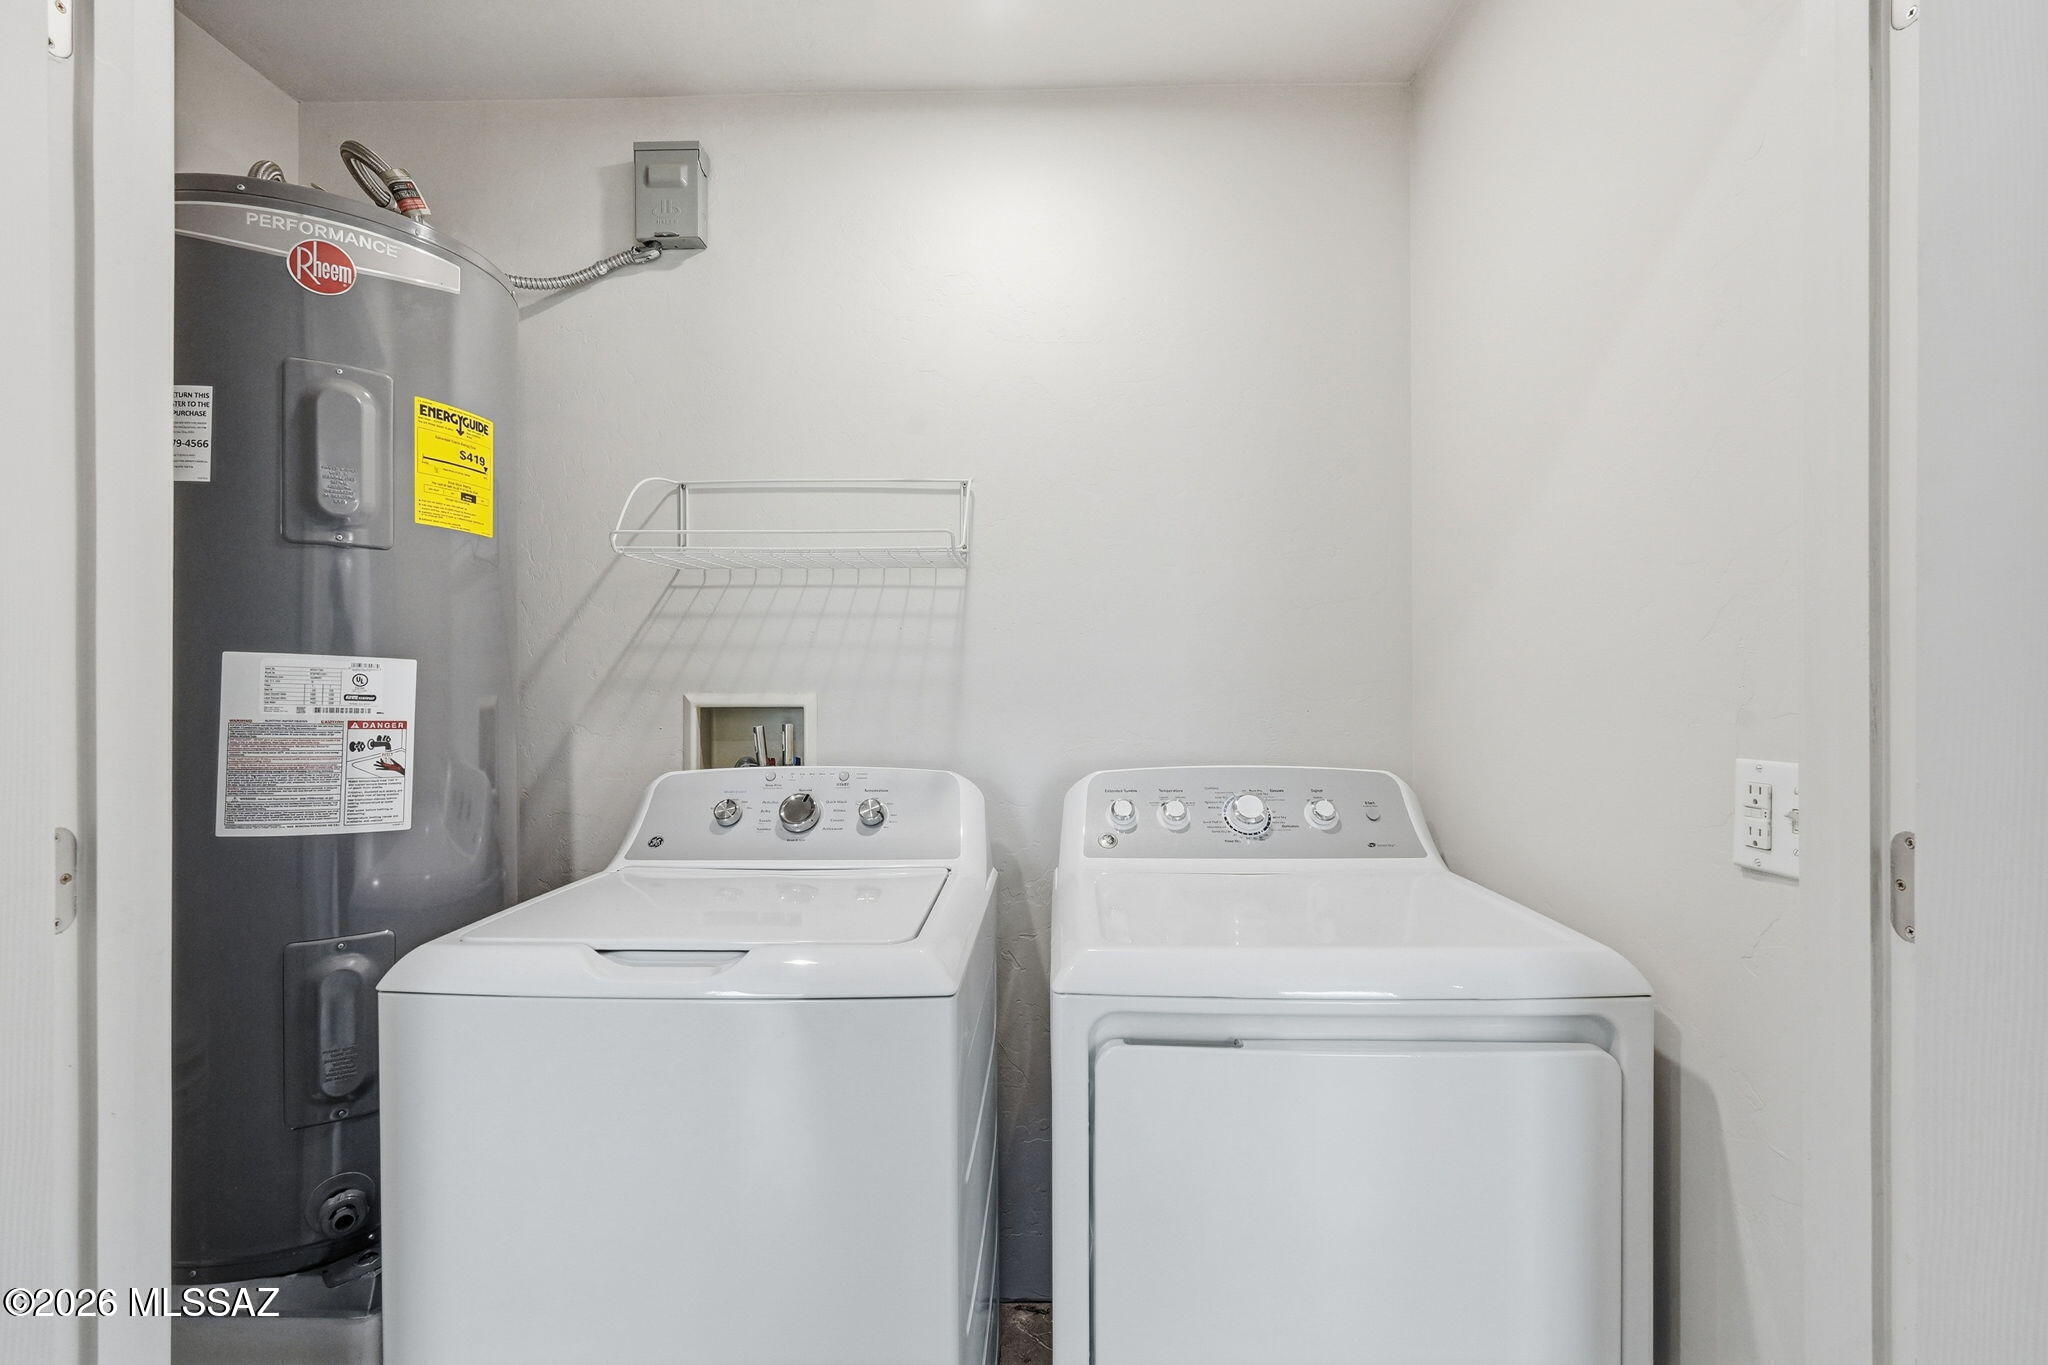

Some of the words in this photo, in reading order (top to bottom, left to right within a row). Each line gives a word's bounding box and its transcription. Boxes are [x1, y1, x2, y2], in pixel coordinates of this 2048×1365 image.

[246, 211, 399, 258] PERFORMANCE
[297, 240, 352, 286] Rheem
[173, 400, 186, 408] TER
[187, 400, 197, 408] TO
[197, 401, 210, 409] THE
[194, 391, 210, 399] THIS
[419, 403, 489, 436] ENERGYGUIDE
